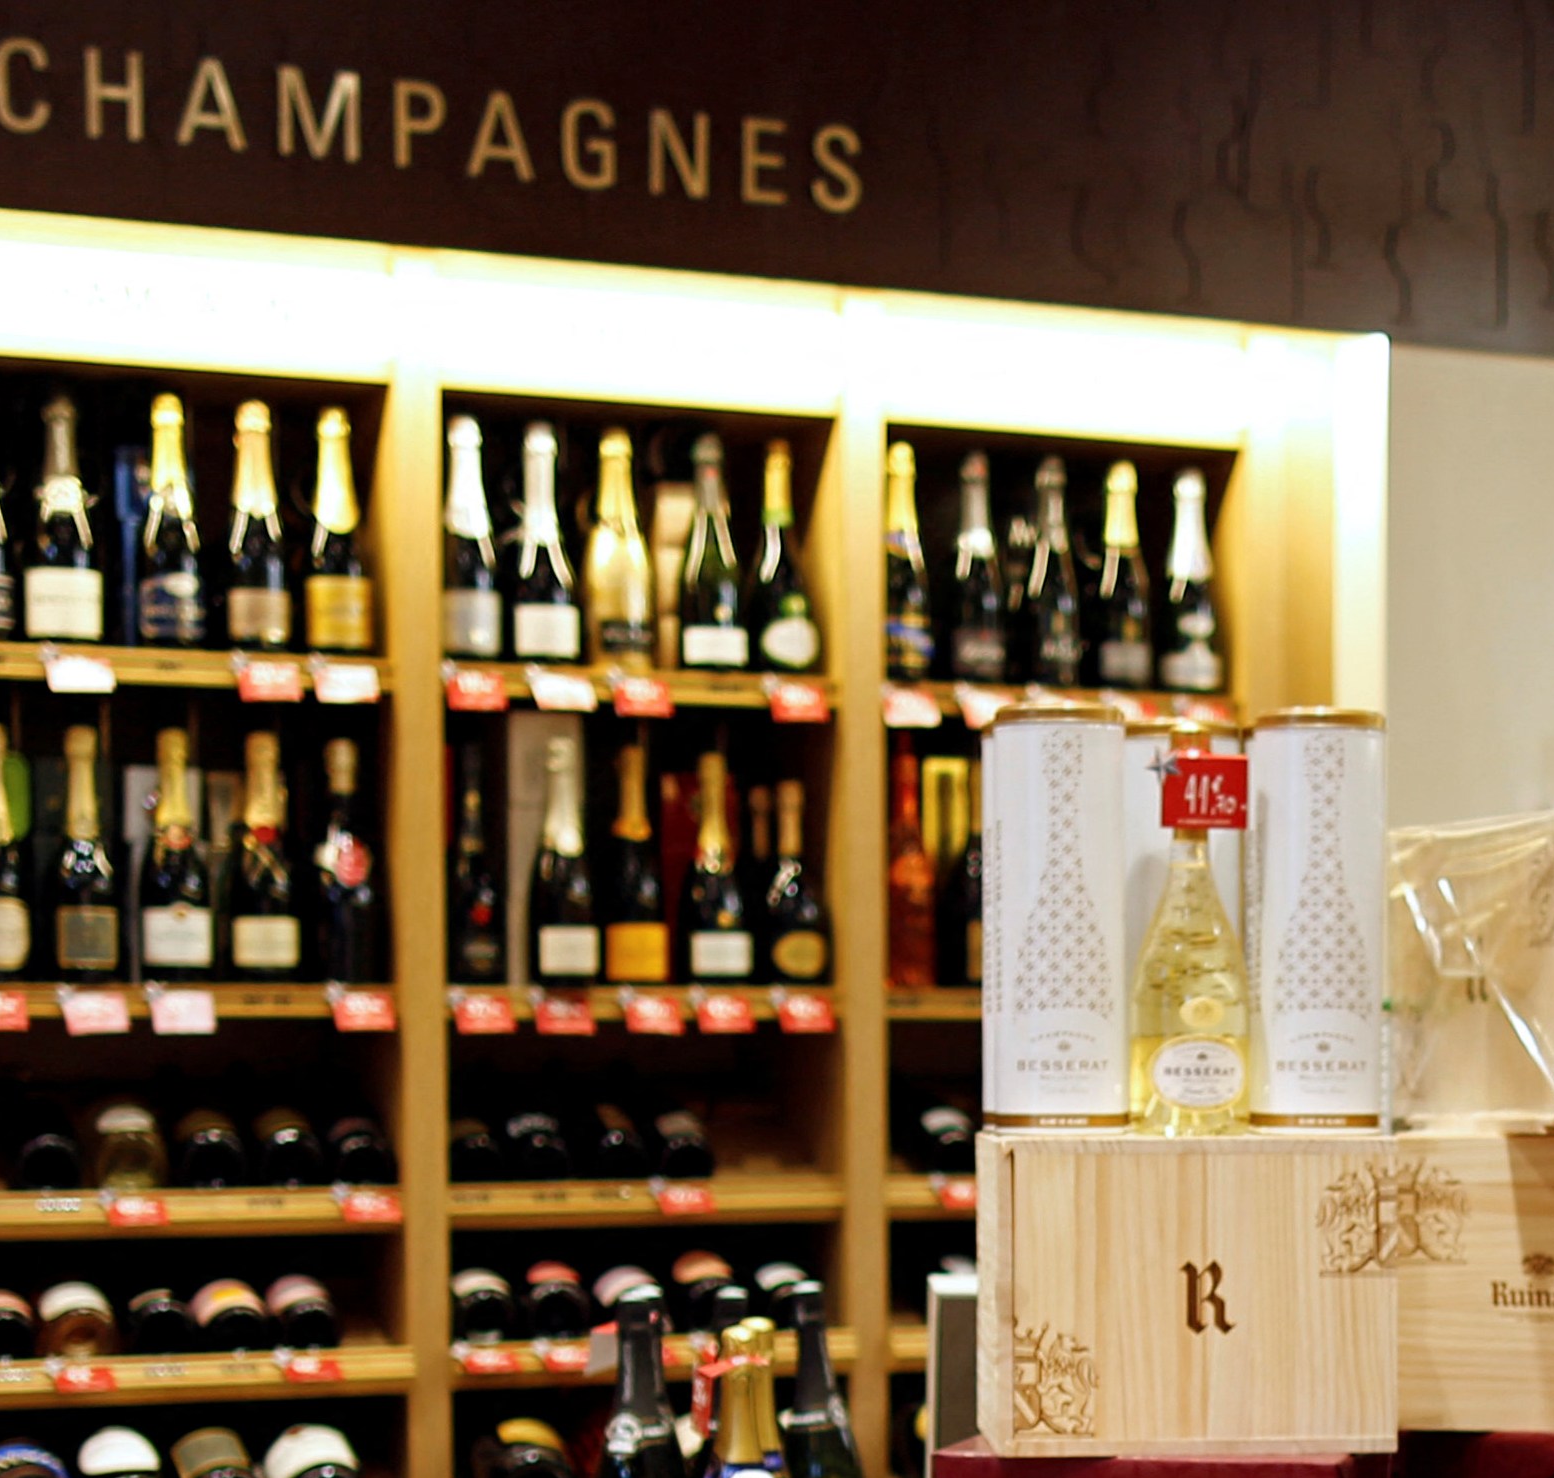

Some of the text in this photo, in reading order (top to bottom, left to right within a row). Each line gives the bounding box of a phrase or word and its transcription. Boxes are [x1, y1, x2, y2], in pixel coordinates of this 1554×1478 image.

[1017, 1060, 1108, 1071] BESSERAT
[1276, 1060, 1367, 1072] BESSERAT
[1163, 1066, 1236, 1077] BESSERAT
[1179, 1259, 1236, 1336] R
